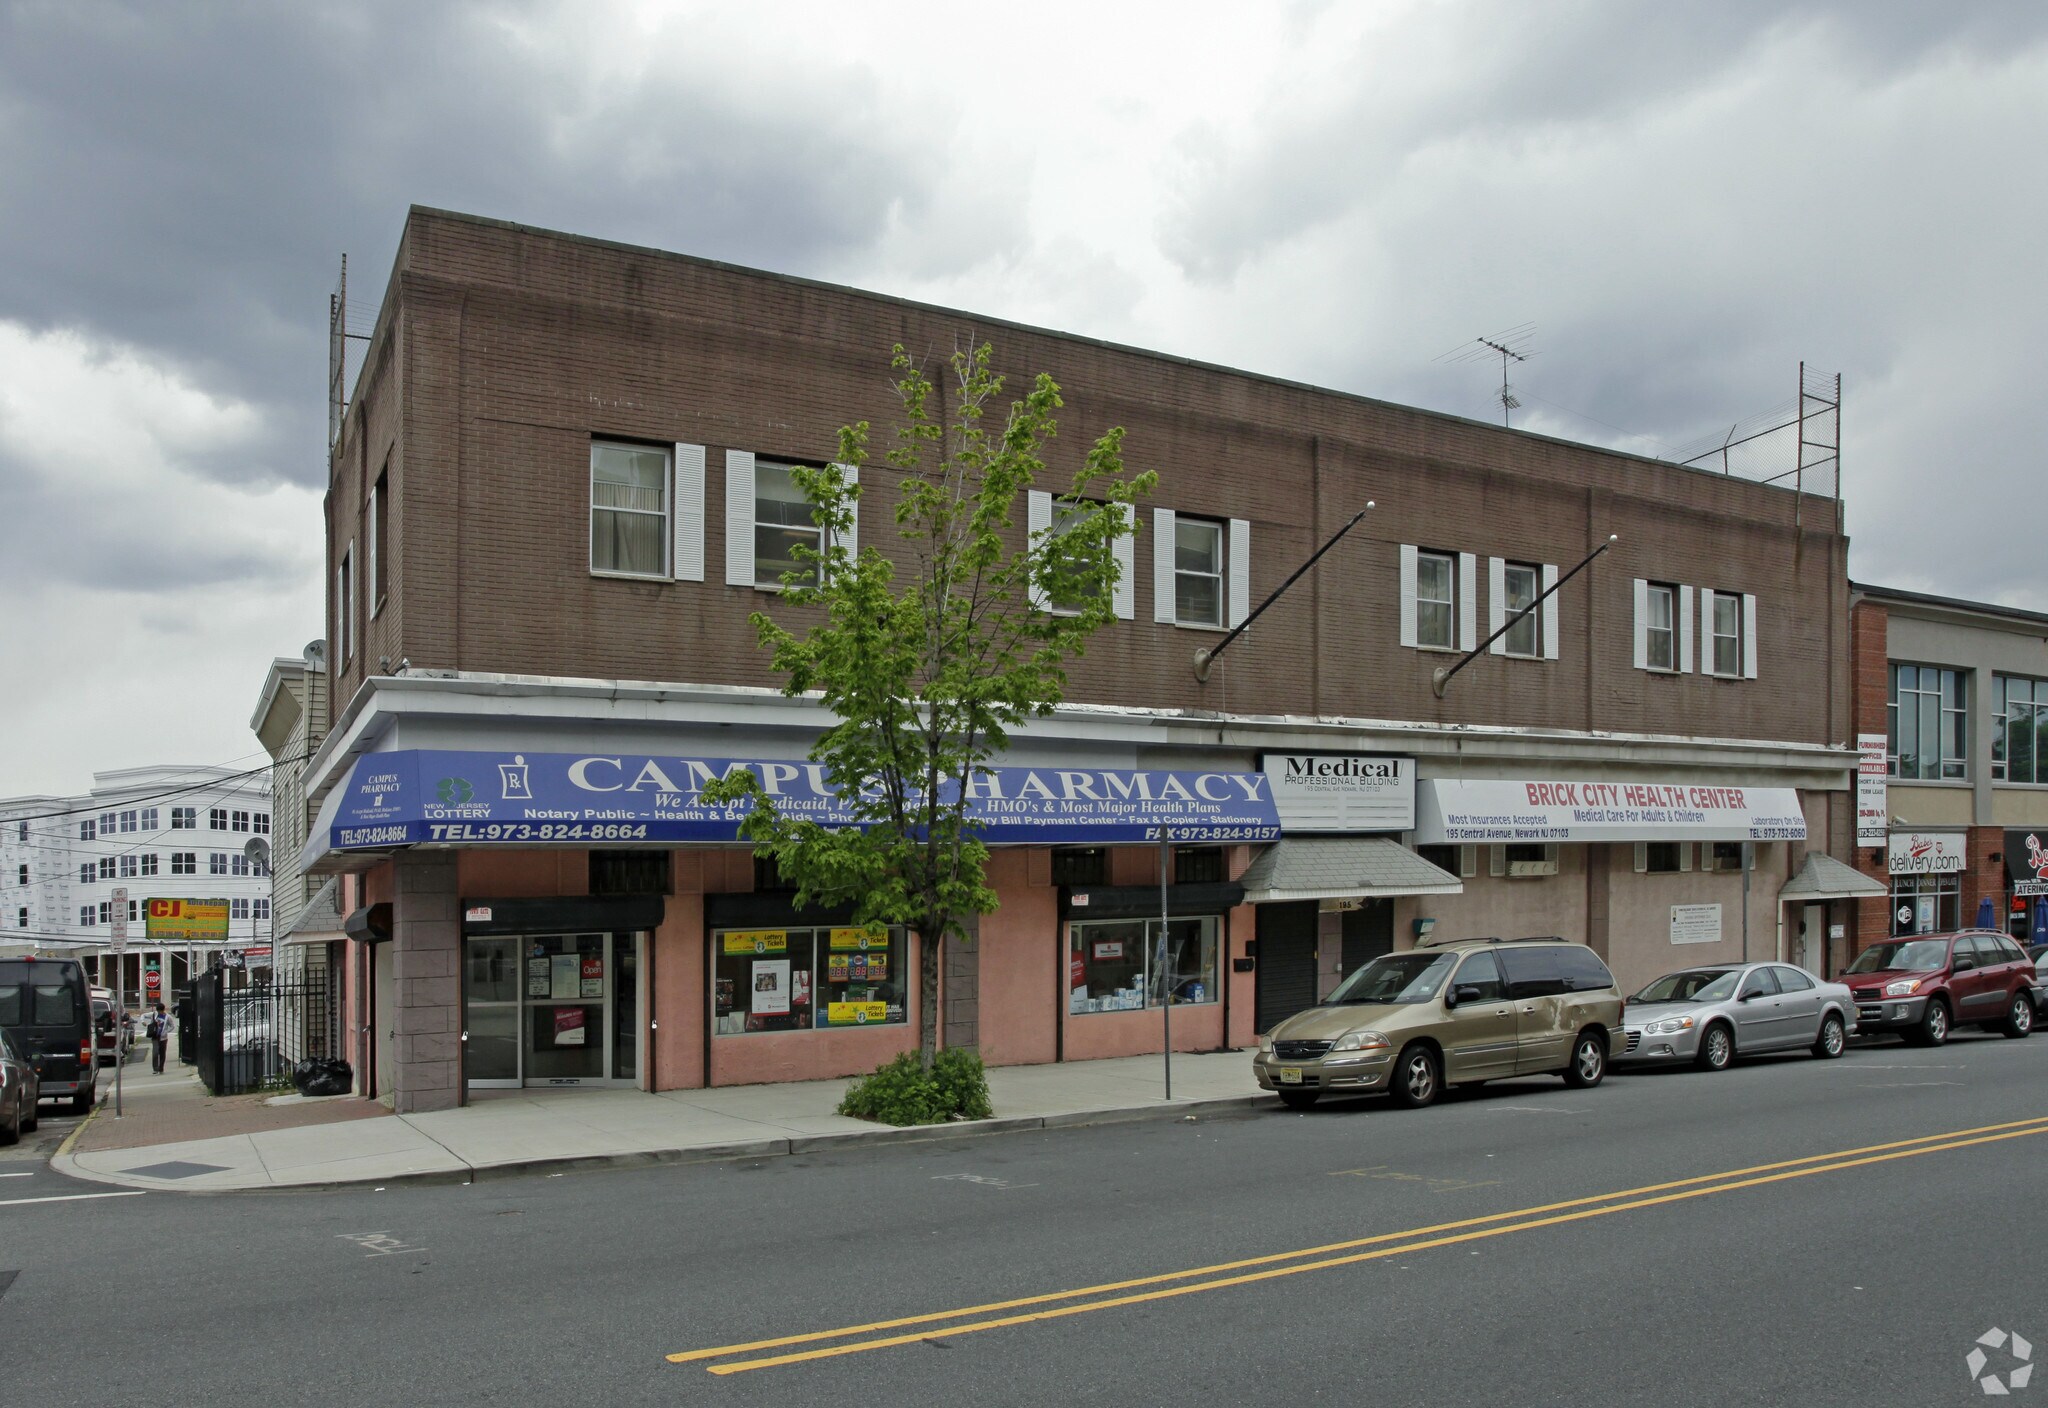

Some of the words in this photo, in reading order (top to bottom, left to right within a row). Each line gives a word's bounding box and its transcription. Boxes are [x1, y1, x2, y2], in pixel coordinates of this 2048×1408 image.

[1285, 757, 1400, 778] Medical
[1859, 765, 1885, 773] AVAILABLE
[368, 774, 398, 785] CAMPUS
[1284, 775, 1355, 787] PROFESSIONAL
[361, 782, 401, 794] PHARMACY
[1525, 783, 1580, 806] BRICK
[1582, 784, 1619, 807] CITY
[1623, 785, 1687, 808] HEALTH
[1689, 787, 1747, 810] CENTER
[655, 793, 681, 808] We
[987, 799, 1038, 813] HMO's
[1043, 800, 1056, 813] &
[1060, 801, 1093, 814] Most
[1099, 801, 1138, 816] Major
[1141, 801, 1184, 814] Health
[1188, 801, 1221, 814] Plans
[424, 809, 491, 819] LOTTERY
[524, 809, 580, 821] Notary
[585, 809, 636, 820] Public
[654, 810, 704, 821] Health
[709, 811, 720, 821] &
[781, 813, 813, 822] Aids
[1573, 808, 1605, 822] Medical
[1607, 809, 1625, 822] Care
[1626, 810, 1639, 822] For
[1641, 810, 1666, 822] Adults
[1667, 810, 1673, 822] &
[1674, 810, 1705, 823] Children
[1001, 816, 1022, 825] Bill
[1024, 817, 1078, 827] Payment
[1080, 816, 1117, 825] Center
[1129, 816, 1150, 825] Fax
[1152, 816, 1161, 825] &
[1163, 816, 1199, 826] Copier
[1210, 816, 1262, 826] Stationery
[1448, 814, 1468, 825] Most
[1469, 814, 1512, 825] Insurances
[1513, 814, 1548, 827] Accepted
[1751, 816, 1784, 827] Laboratory
[1784, 817, 1793, 825] On
[1793, 816, 1805, 826] Site
[340, 825, 407, 845] TEL:973-824-8664
[429, 824, 647, 840] TEL:973-824-8664
[1446, 829, 1459, 838] 195
[1460, 829, 1486, 838] Central
[1487, 829, 1513, 840] Avenue,
[1515, 829, 1540, 838] Newark
[1540, 829, 1549, 837] NJ
[1550, 829, 1569, 838] 07103
[1749, 828, 1763, 838] TEL:
[1763, 828, 1806, 838] 973-732-6060
[1889, 852, 1960, 873] delivery.com
[1897, 878, 1914, 888] LUNCH
[150, 899, 181, 917] CJ
[764, 933, 783, 942] Lottery
[583, 966, 602, 976] Open
[865, 1005, 883, 1013] Lottery
[868, 1009, 885, 1017] Tickets
